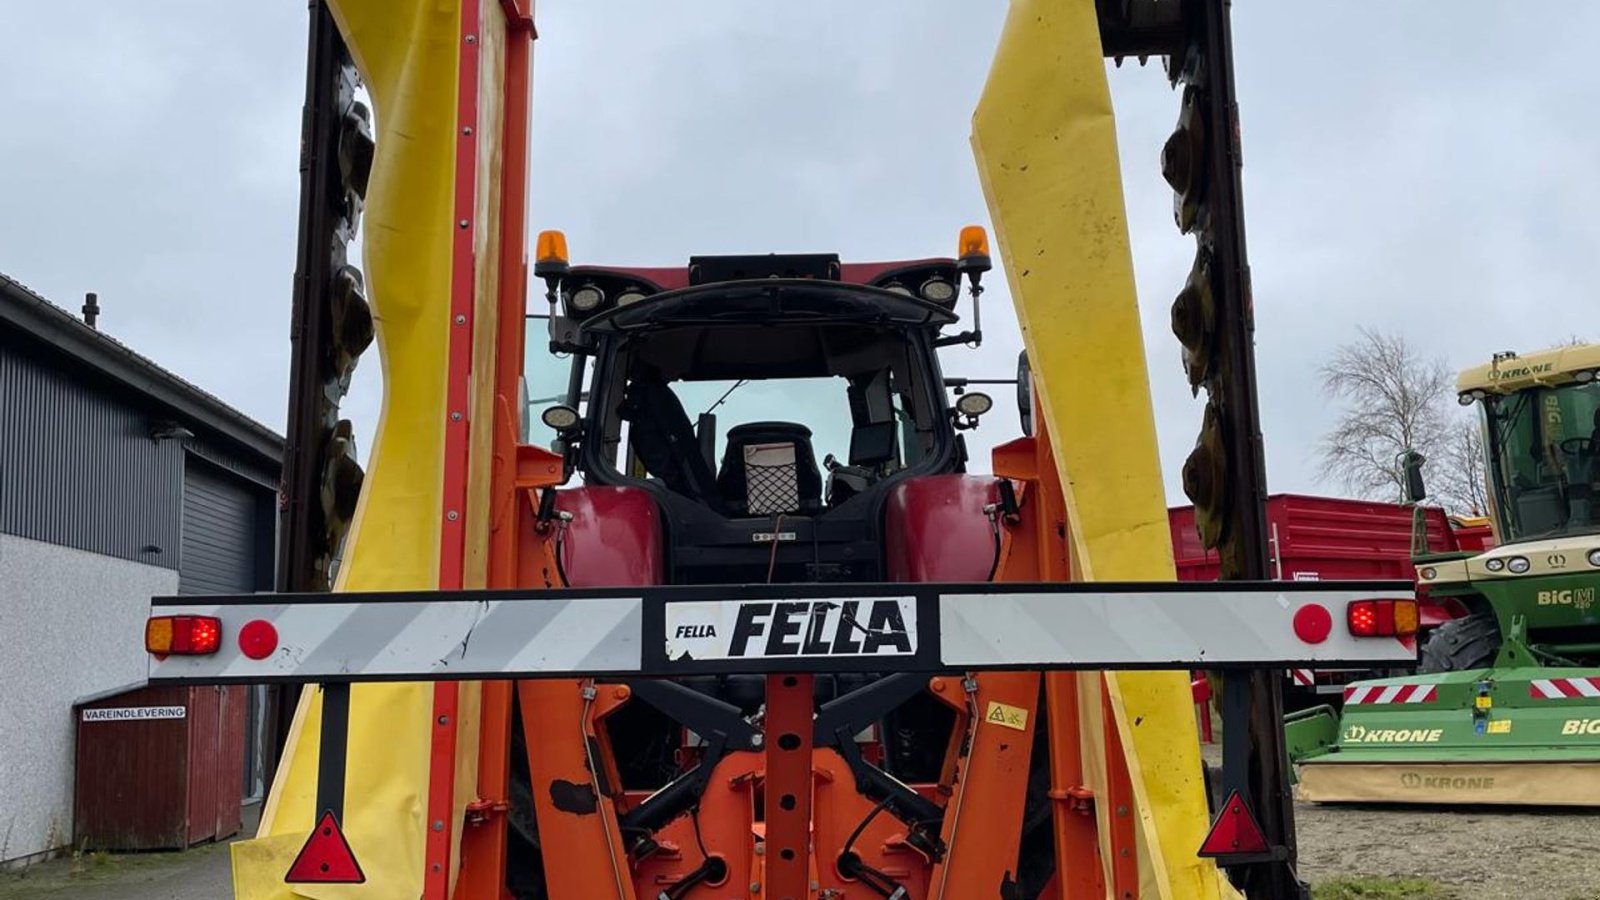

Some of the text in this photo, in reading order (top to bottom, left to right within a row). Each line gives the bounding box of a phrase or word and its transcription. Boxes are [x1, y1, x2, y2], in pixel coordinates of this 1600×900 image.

[1502, 363, 1553, 379] KRONE
[675, 625, 716, 638] FELLA
[728, 600, 912, 656] FELLA
[84, 708, 185, 719] VAREINDLEVERING
[1562, 719, 1600, 734] BiG
[1364, 729, 1443, 742] KRONE
[1424, 777, 1495, 789] KRONE
